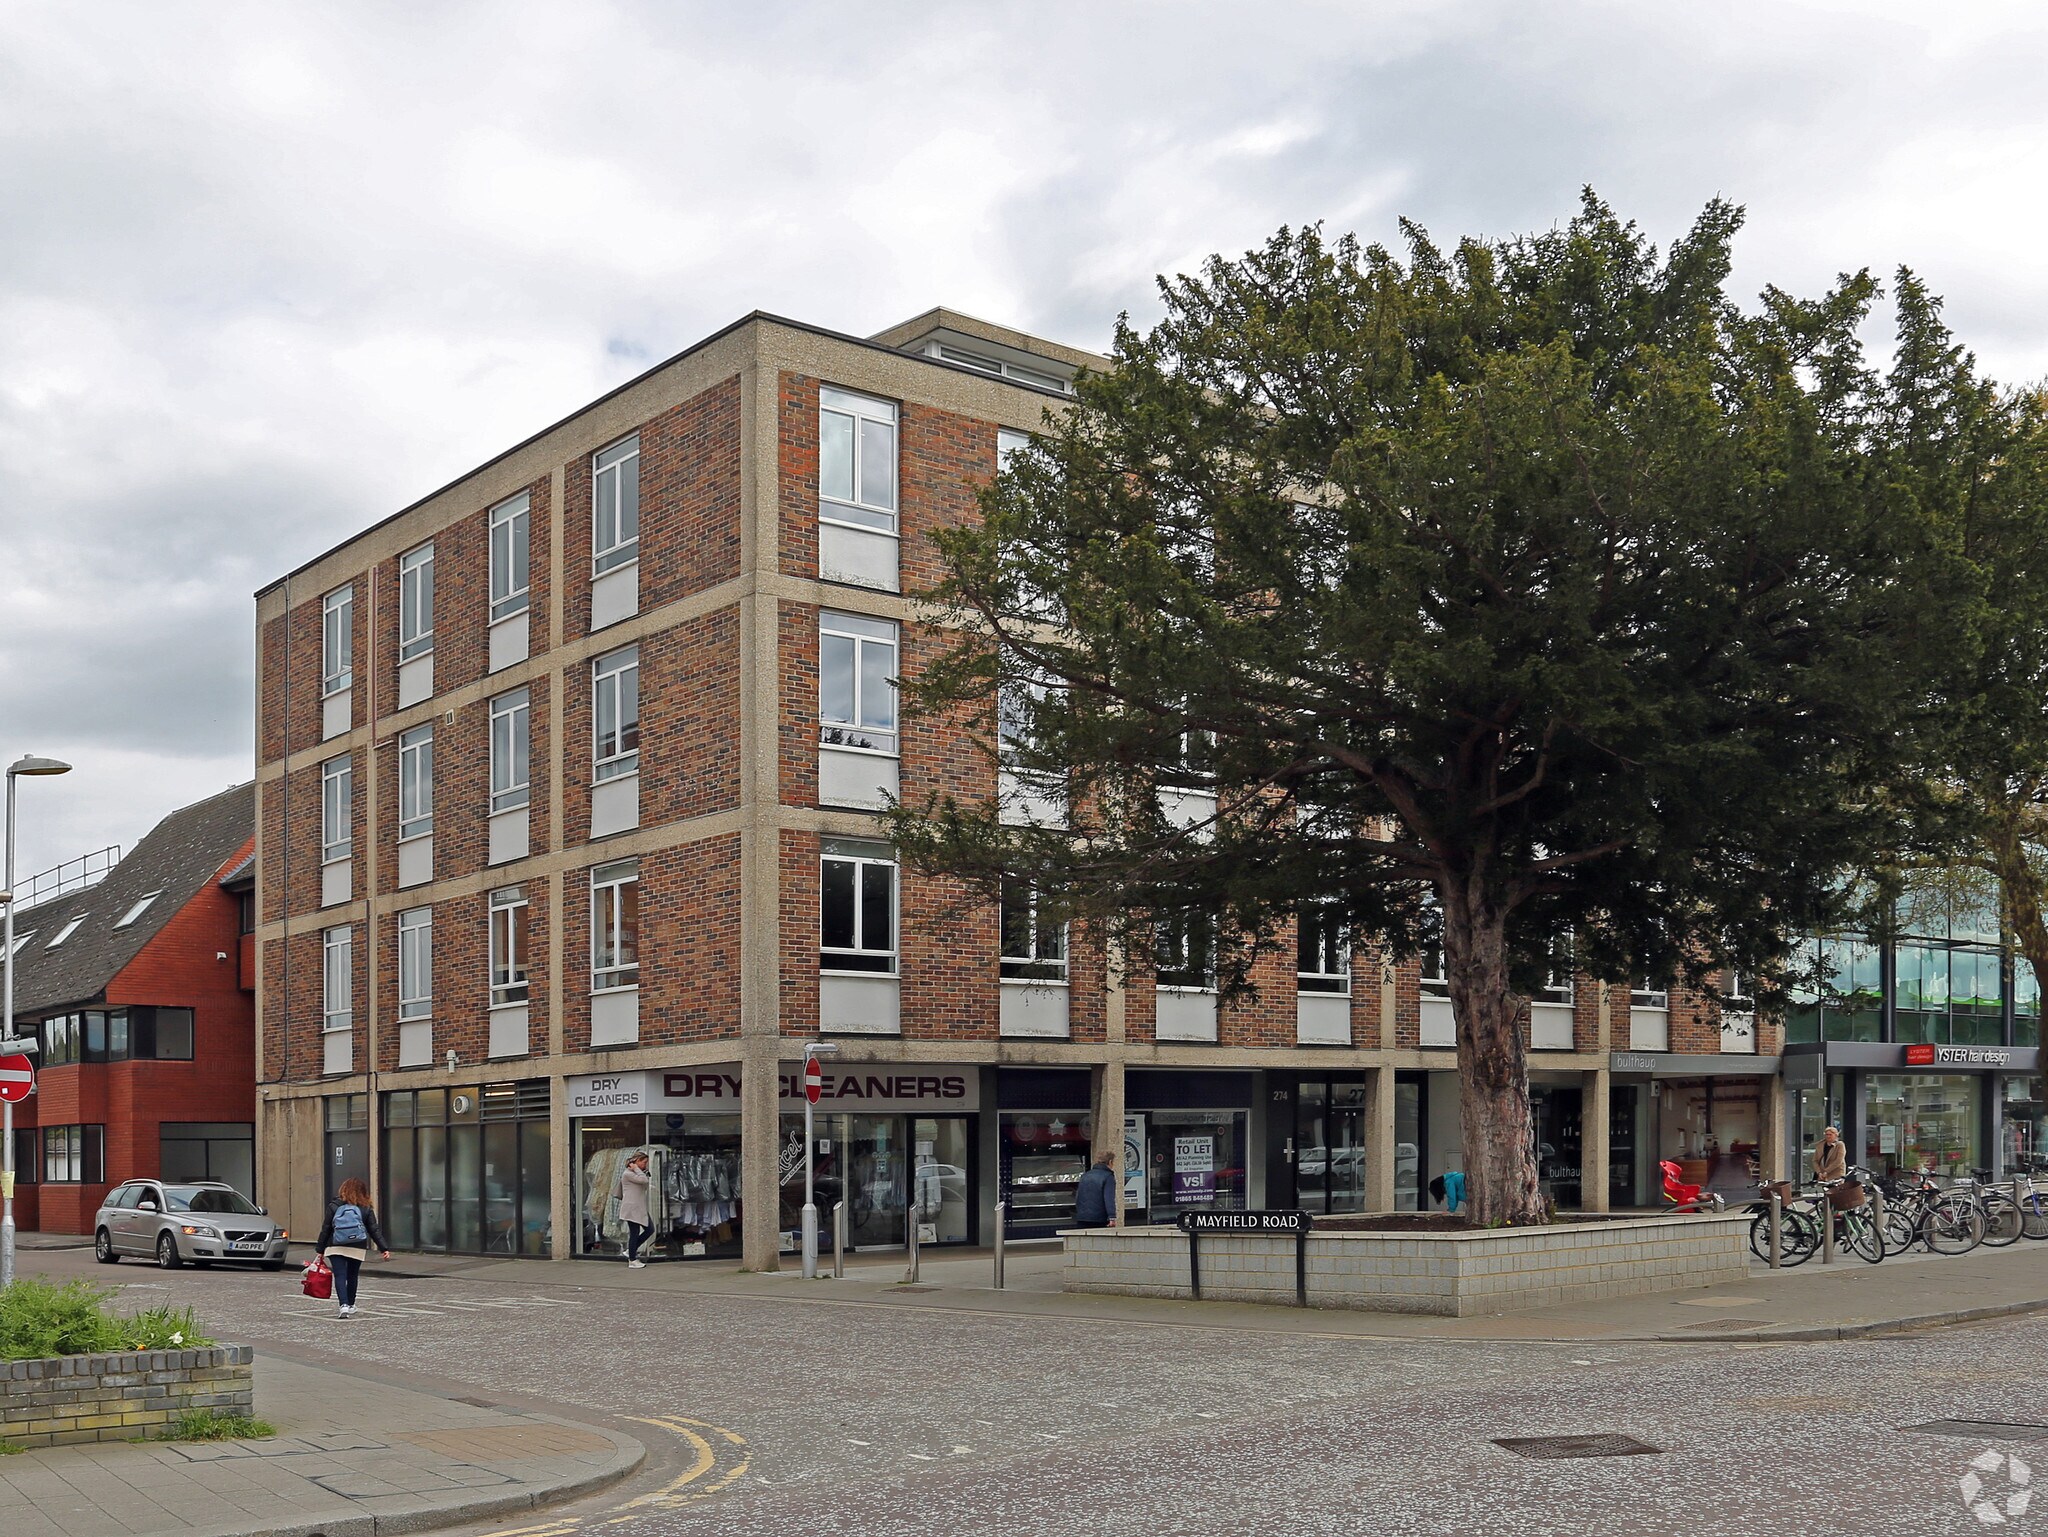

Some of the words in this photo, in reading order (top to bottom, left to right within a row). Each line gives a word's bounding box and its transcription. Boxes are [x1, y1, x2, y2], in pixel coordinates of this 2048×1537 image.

[1938, 1048, 1968, 1062] YSTER
[1617, 1055, 1656, 1069] bulthaup
[592, 1078, 621, 1091] DRY
[664, 1074, 743, 1098] DRY
[575, 1093, 639, 1107] CLEANERS
[1273, 1091, 1288, 1100] 274
[1350, 1089, 1366, 1103] 27
[1177, 1145, 1190, 1154] TO
[1194, 1144, 1211, 1154] LET
[1549, 1166, 1582, 1178] bulthau
[1196, 1215, 1258, 1227] MAYFIELD
[1262, 1215, 1298, 1227] ROAD
